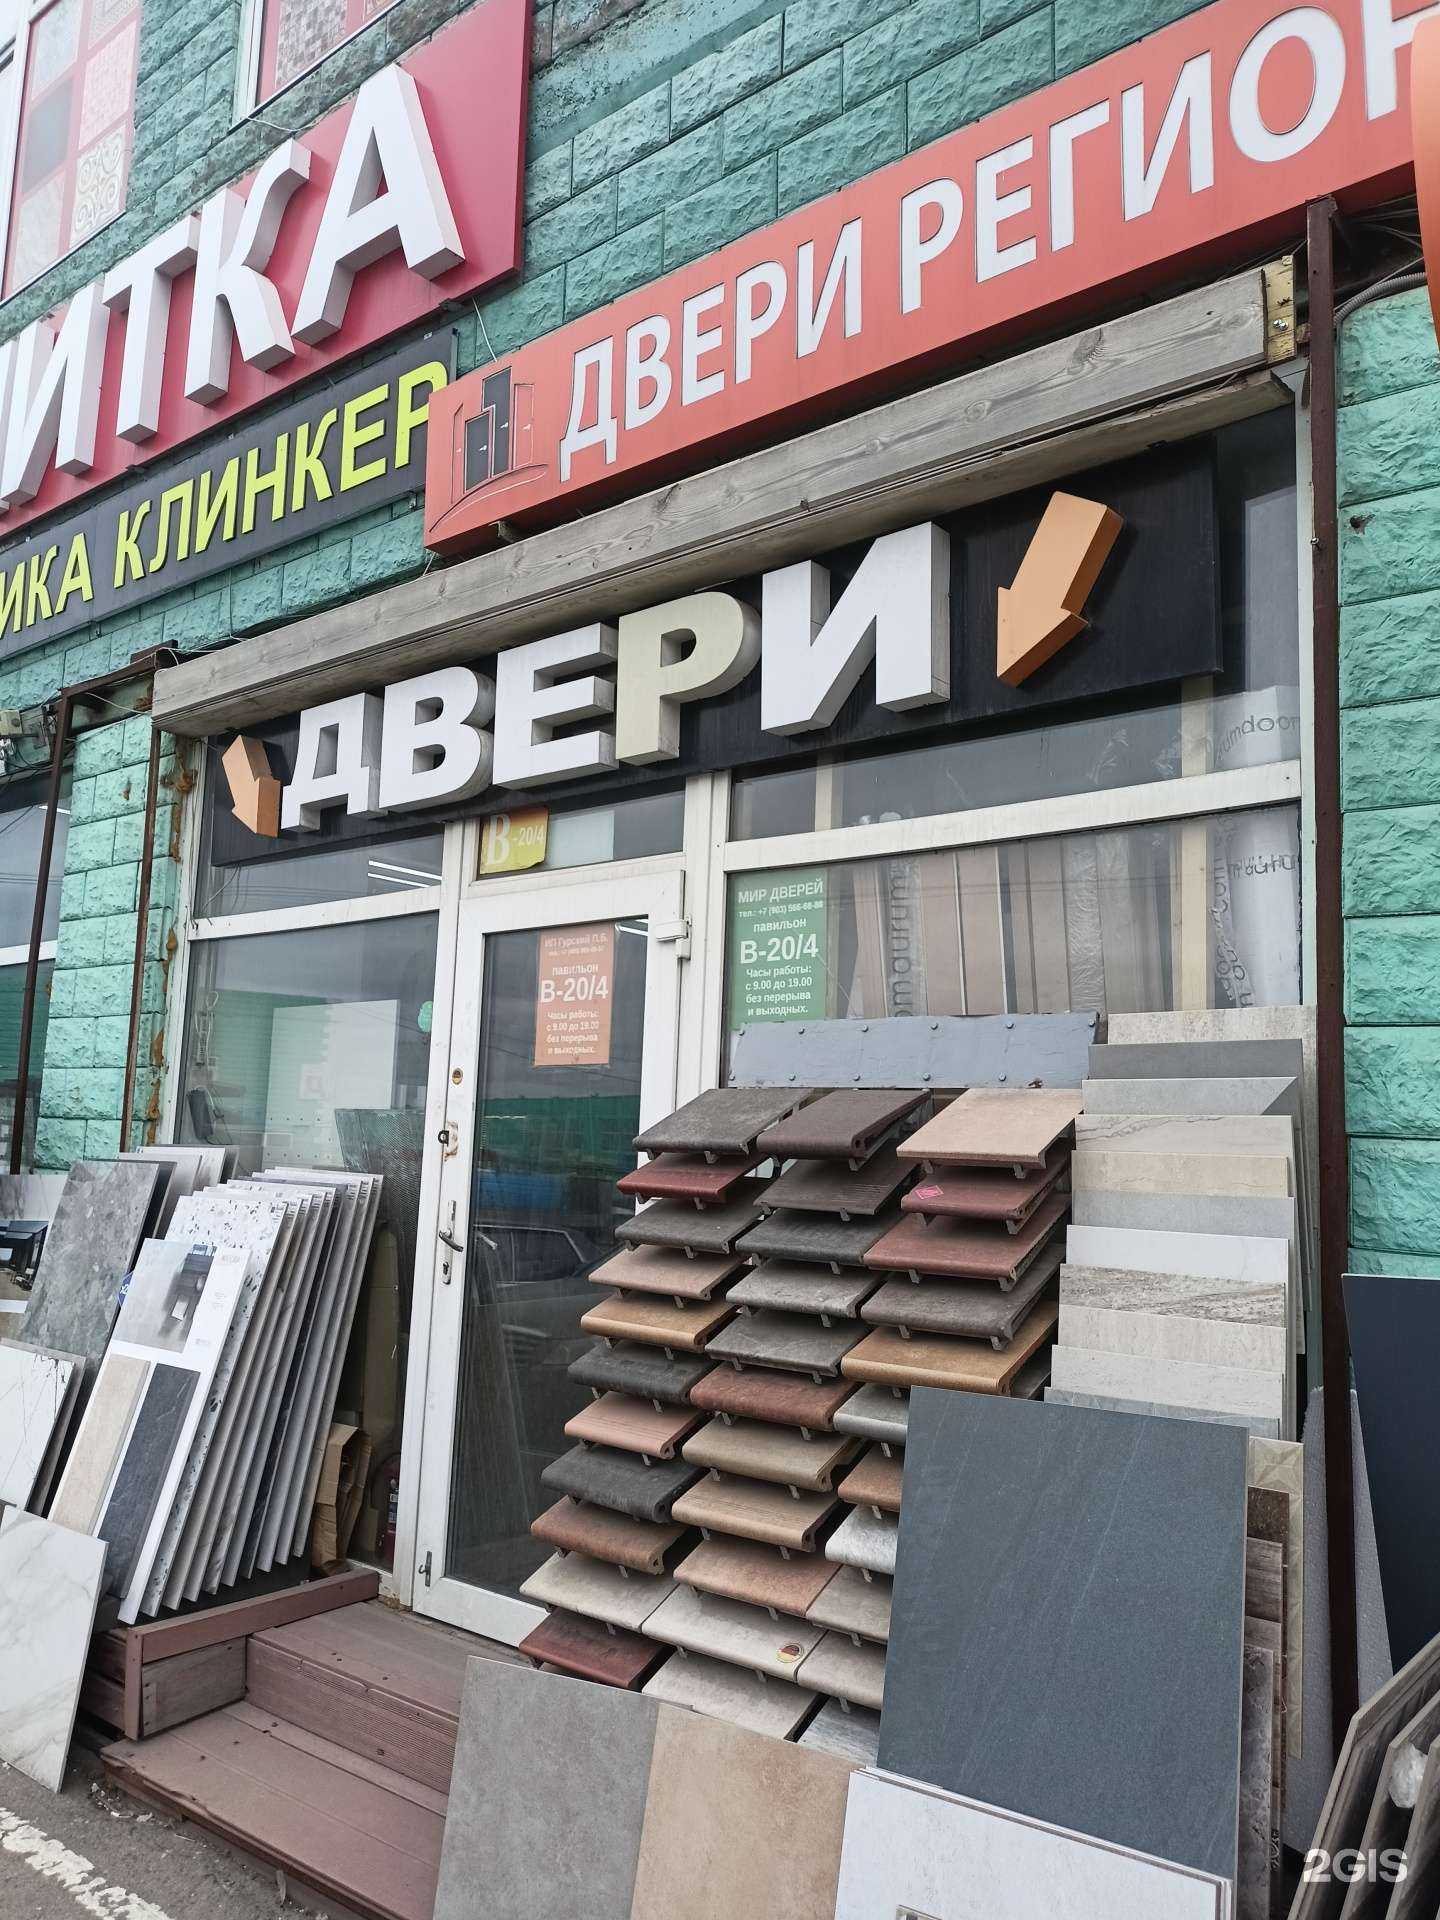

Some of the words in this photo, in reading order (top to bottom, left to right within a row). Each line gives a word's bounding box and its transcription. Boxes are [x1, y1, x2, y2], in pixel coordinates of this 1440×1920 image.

[560, 216, 863, 484] ДВЕРИ
[114, 360, 450, 588] КЛИНКЕР
[281, 520, 951, 833] ДВЕРИ
[738, 888, 767, 904] МИР
[769, 878, 823, 902] ДВЕРЕЙ
[753, 918, 807, 933] павильон
[740, 933, 819, 964] В-20/4
[746, 967, 771, 978] Часы
[773, 964, 812, 977] работы:
[753, 980, 772, 990] 9.00
[773, 980, 786, 990] до
[788, 977, 813, 988] 19.00
[540, 975, 609, 1002] В-20/4
[745, 993, 762, 1004] без
[763, 991, 811, 1003] перерыва
[755, 1005, 809, 1016] выходных.
